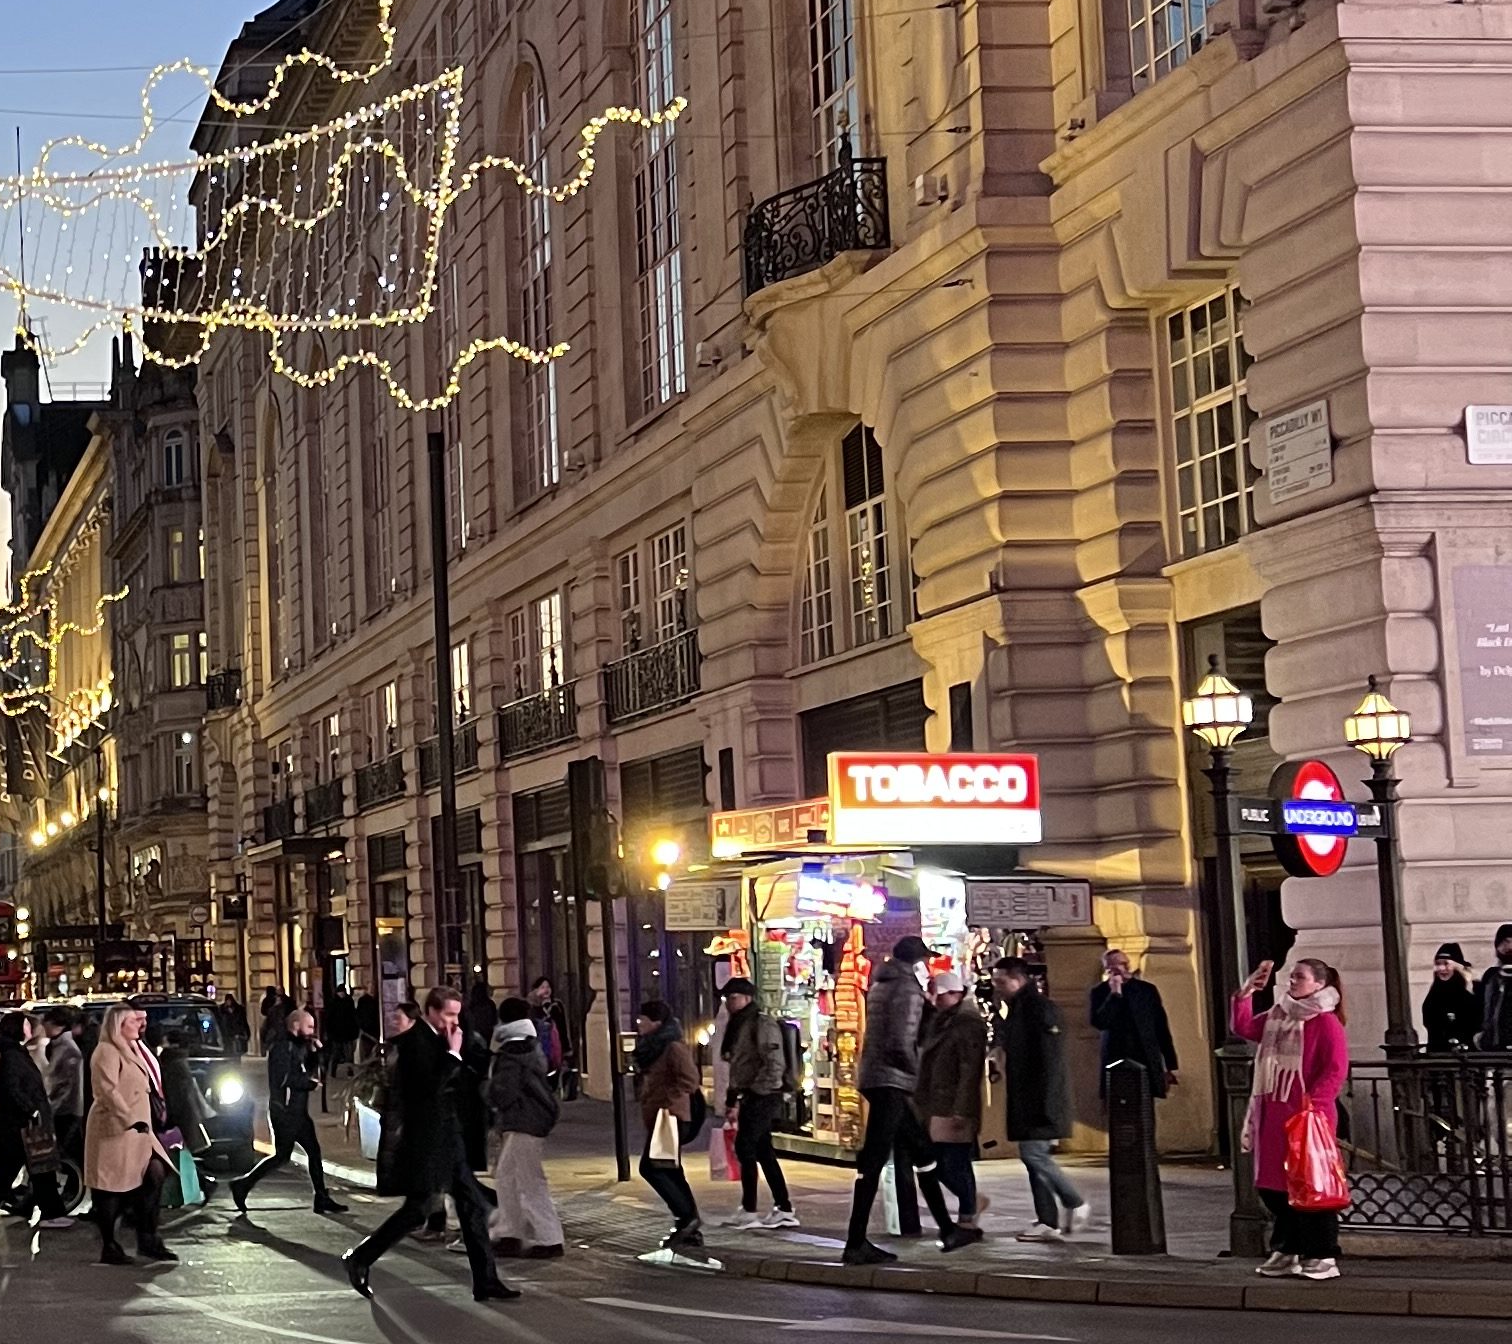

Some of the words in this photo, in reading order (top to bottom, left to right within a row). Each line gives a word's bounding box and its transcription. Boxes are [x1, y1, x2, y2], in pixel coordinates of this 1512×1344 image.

[848, 765, 1028, 803] TOBACCO
[1284, 809, 1354, 827] UNDERGROUND
[44, 939, 69, 947] THE
